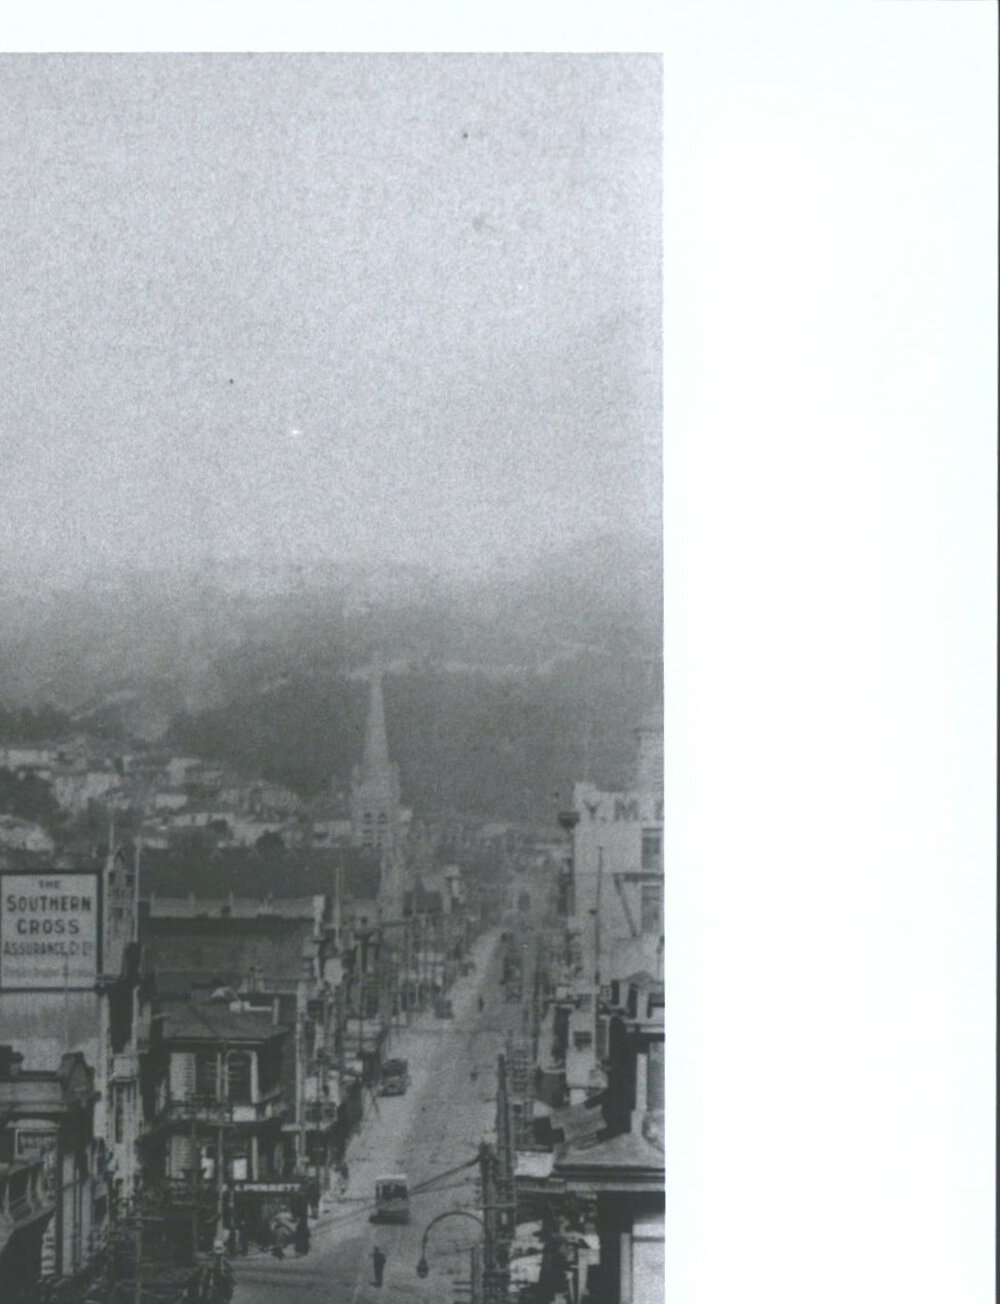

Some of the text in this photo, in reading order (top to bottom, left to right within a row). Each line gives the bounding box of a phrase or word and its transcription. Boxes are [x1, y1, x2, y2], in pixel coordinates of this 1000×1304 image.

[38, 880, 62, 890] THE
[6, 894, 92, 912] SOUTHERN
[16, 918, 81, 935] CROSS
